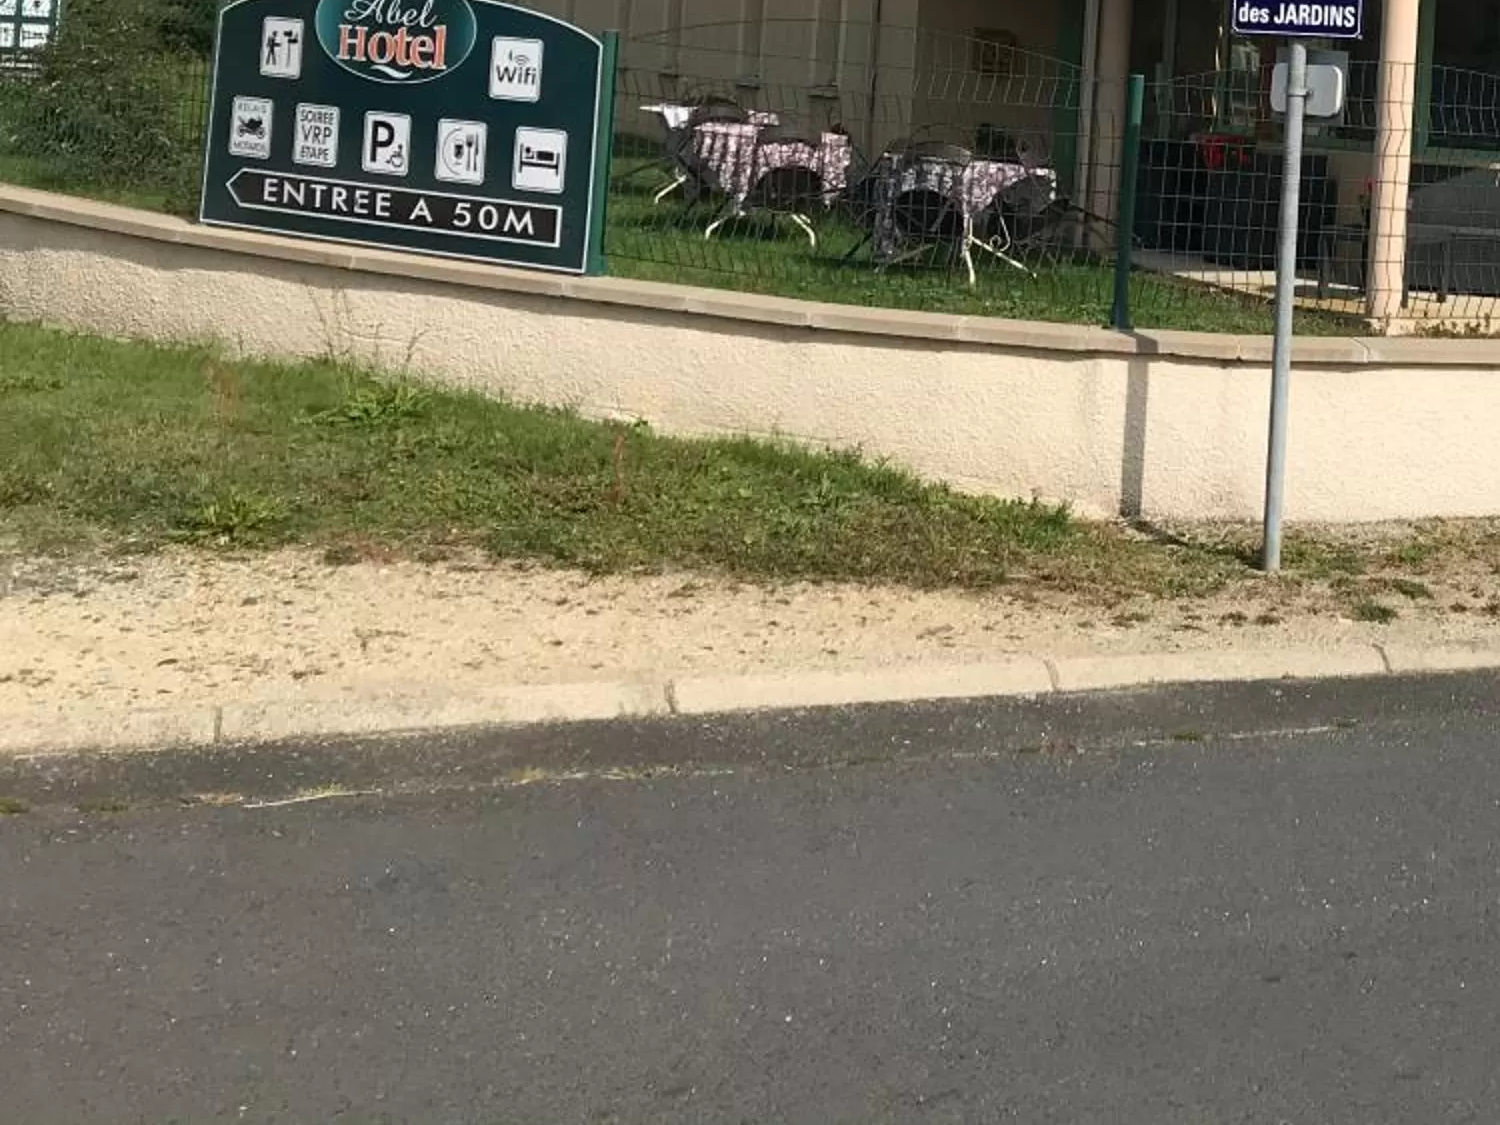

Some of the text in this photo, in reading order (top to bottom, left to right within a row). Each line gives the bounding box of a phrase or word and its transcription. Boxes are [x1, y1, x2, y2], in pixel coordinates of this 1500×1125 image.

[1238, 1, 1356, 28] des JARDINS
[335, 24, 447, 70] Hotel
[496, 64, 537, 86] Wifi
[301, 124, 333, 145] VRP
[370, 120, 395, 163] P
[300, 145, 330, 162] ETAPE
[262, 177, 535, 236] ENTREE A 50M
